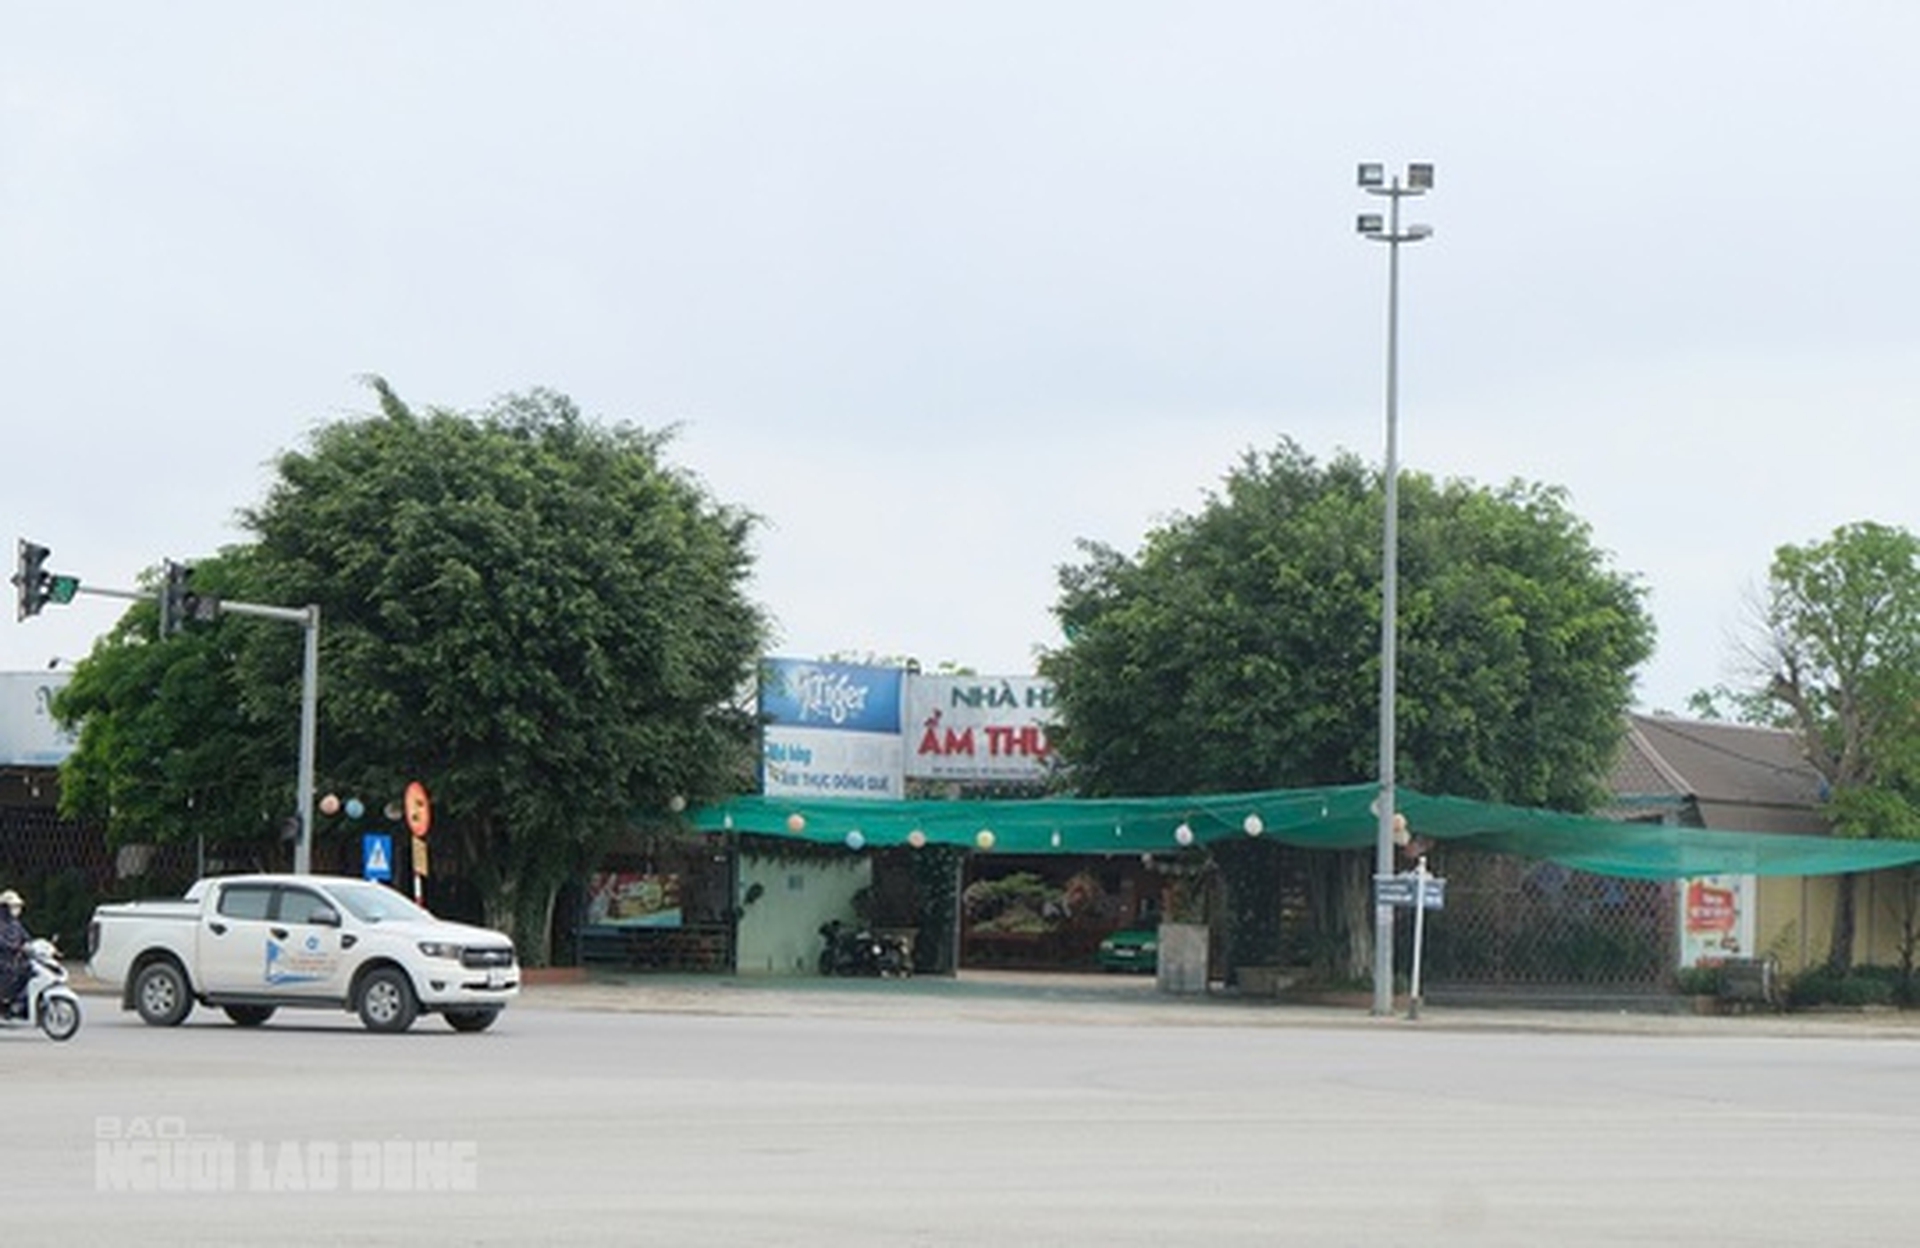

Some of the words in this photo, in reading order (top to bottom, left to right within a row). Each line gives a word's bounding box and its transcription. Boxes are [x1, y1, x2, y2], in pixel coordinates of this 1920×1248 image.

[952, 679, 1018, 708] NHÀ
[1026, 686, 1051, 708] H
[917, 708, 975, 756] ẨM
